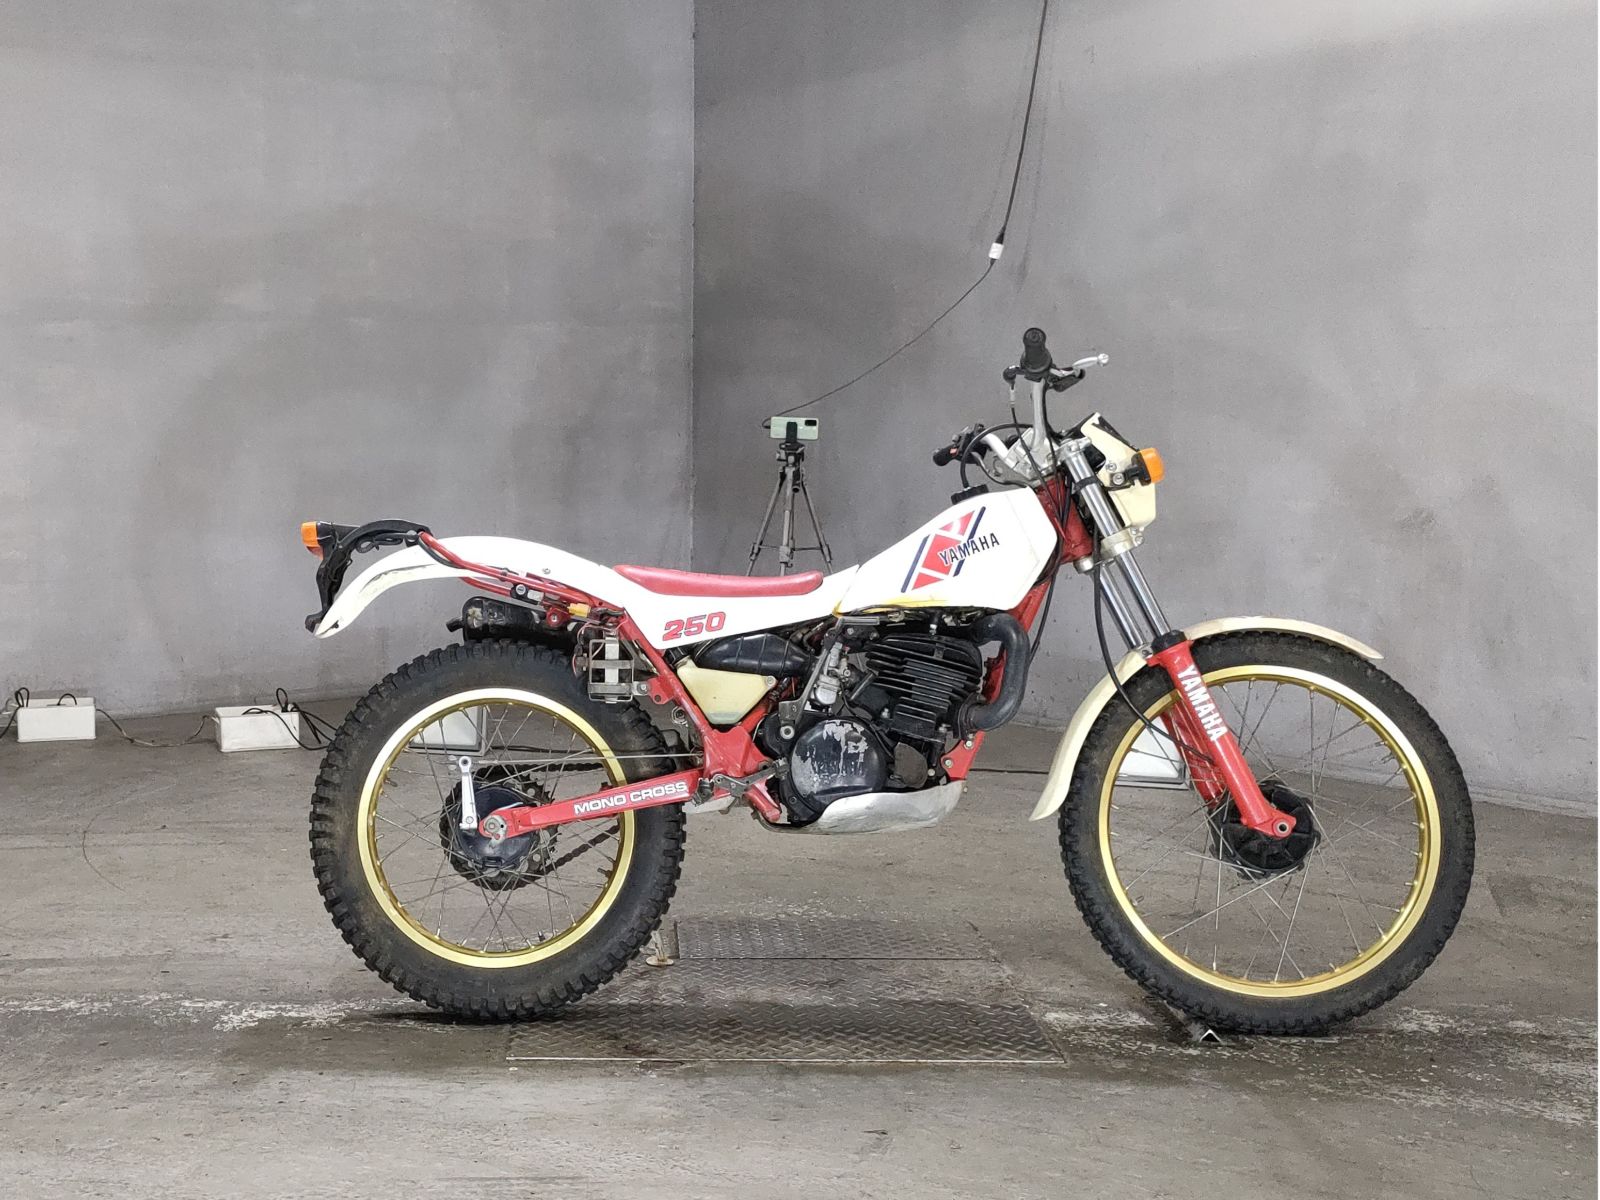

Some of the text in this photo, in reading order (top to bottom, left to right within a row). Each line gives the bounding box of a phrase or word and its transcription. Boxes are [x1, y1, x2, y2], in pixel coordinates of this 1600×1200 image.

[939, 532, 1000, 565] YAMAHA
[662, 611, 726, 641] 250
[1177, 664, 1228, 741] YAMAHA
[573, 781, 689, 815] MONO CROSS
